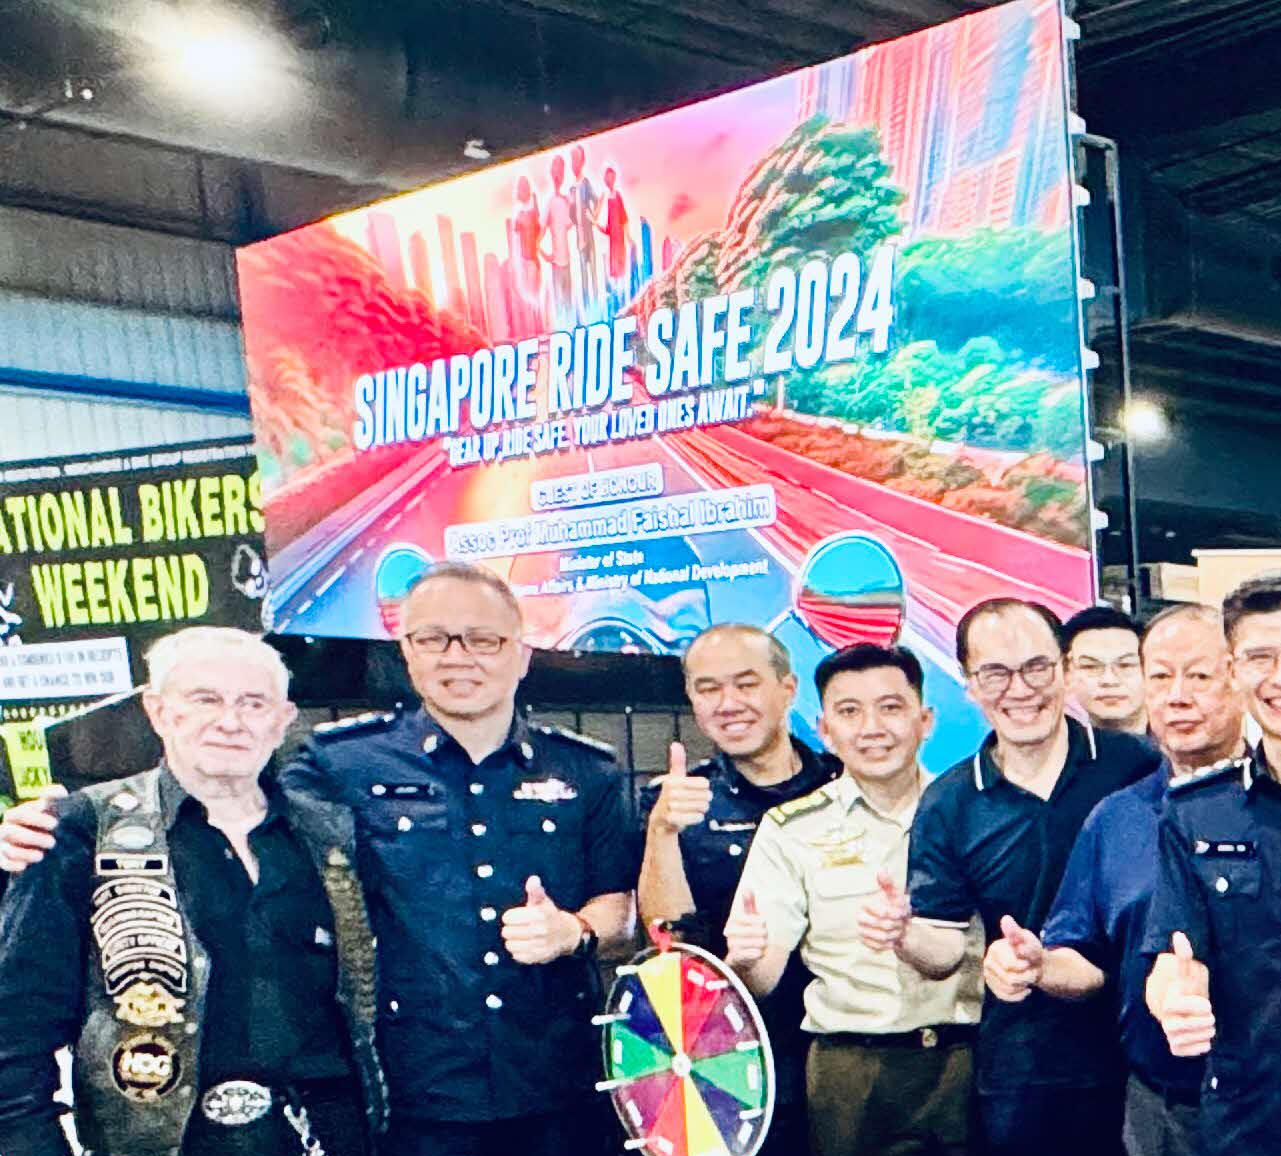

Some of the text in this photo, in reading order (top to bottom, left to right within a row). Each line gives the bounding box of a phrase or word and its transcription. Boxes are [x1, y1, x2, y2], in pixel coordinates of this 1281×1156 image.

[353, 244, 898, 451] SINGAPORE RIDE SAFE 2024
[573, 411, 608, 446] YOUR
[610, 404, 657, 440] LOVED
[534, 509, 629, 546] Muhammad
[631, 498, 697, 534] Faishal
[699, 492, 771, 526] Ibrahim
[31, 553, 209, 628] WEEKEND
